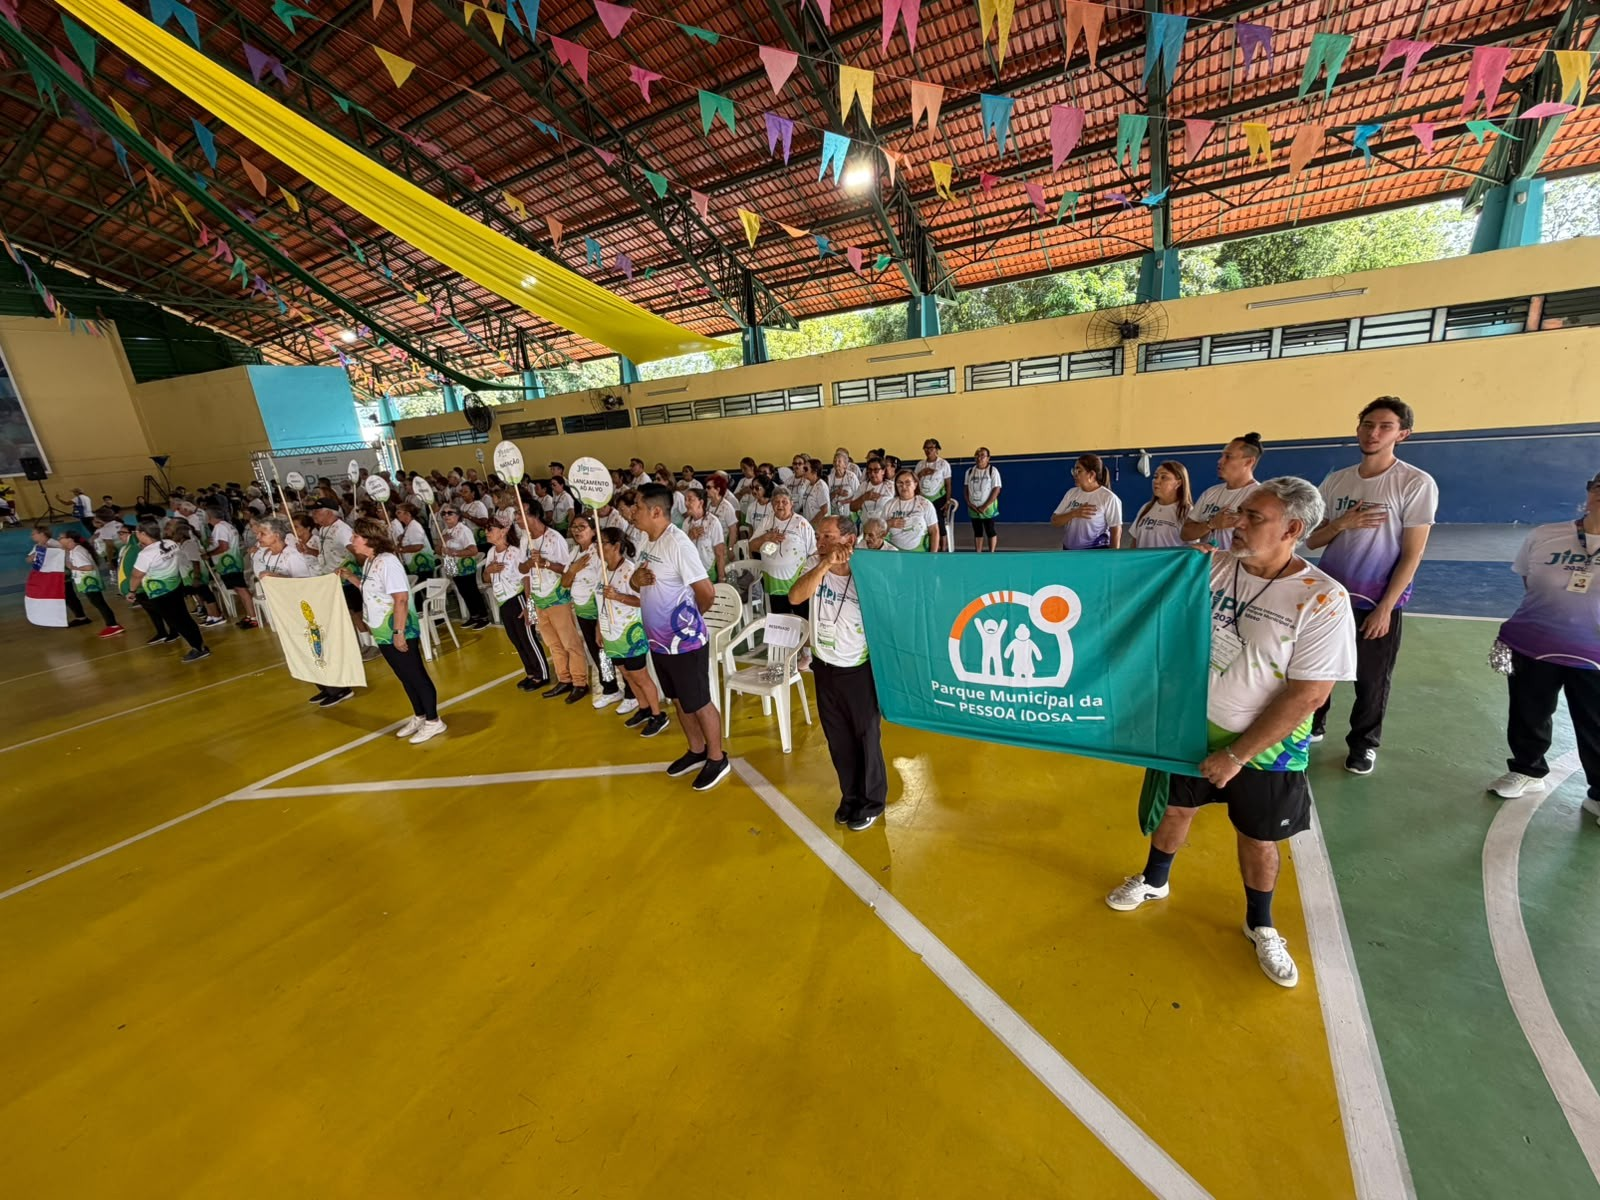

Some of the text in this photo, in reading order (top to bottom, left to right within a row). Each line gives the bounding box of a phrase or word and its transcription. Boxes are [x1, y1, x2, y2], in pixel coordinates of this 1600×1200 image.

[573, 479, 609, 487] LANÇAMENTO
[931, 680, 1103, 710] Parque Municipal da
[959, 702, 1074, 723] PESSOA IDOSA
